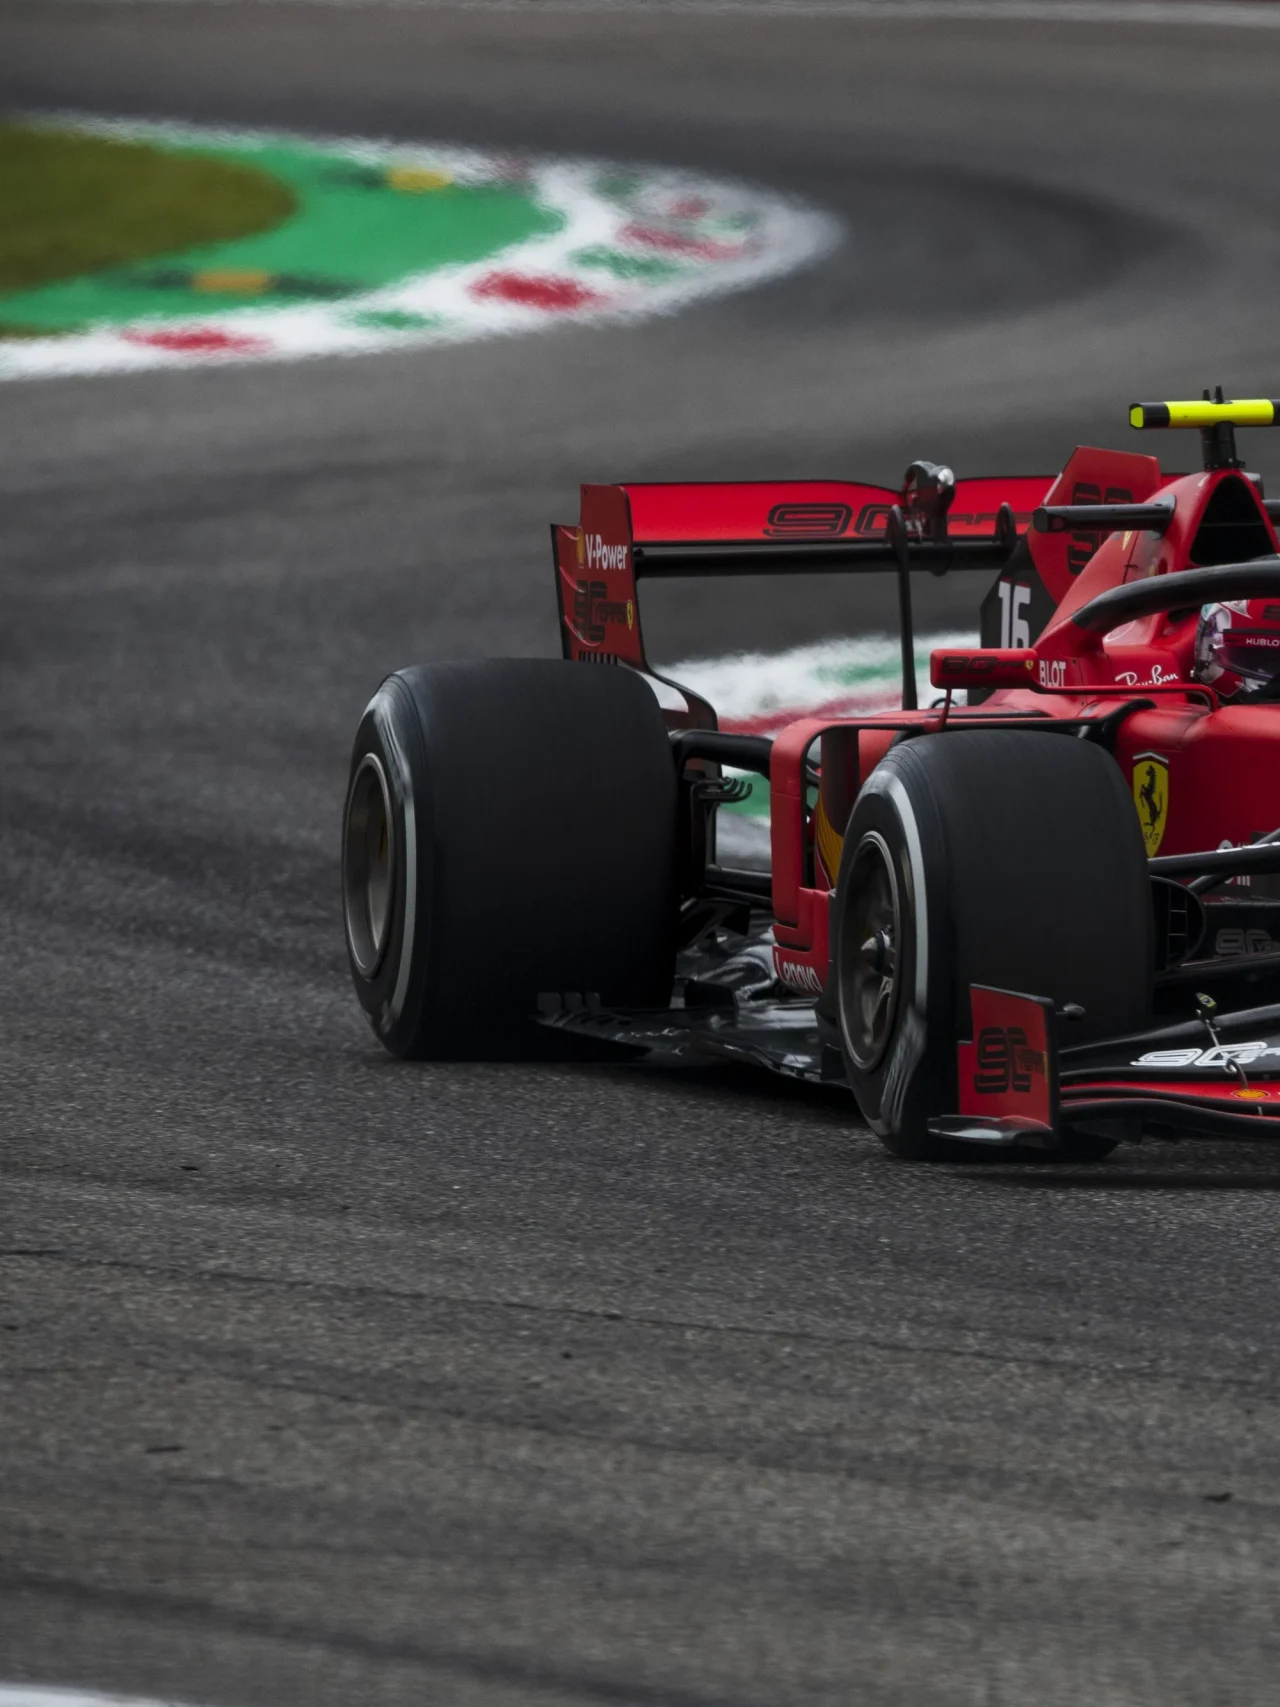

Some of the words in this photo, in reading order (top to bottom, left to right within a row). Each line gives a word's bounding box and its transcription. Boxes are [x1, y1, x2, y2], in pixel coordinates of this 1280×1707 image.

[585, 533, 628, 570] V-Power
[998, 576, 1032, 648] 16
[1039, 660, 1067, 688] BLOT
[774, 952, 825, 994] Lenovo
